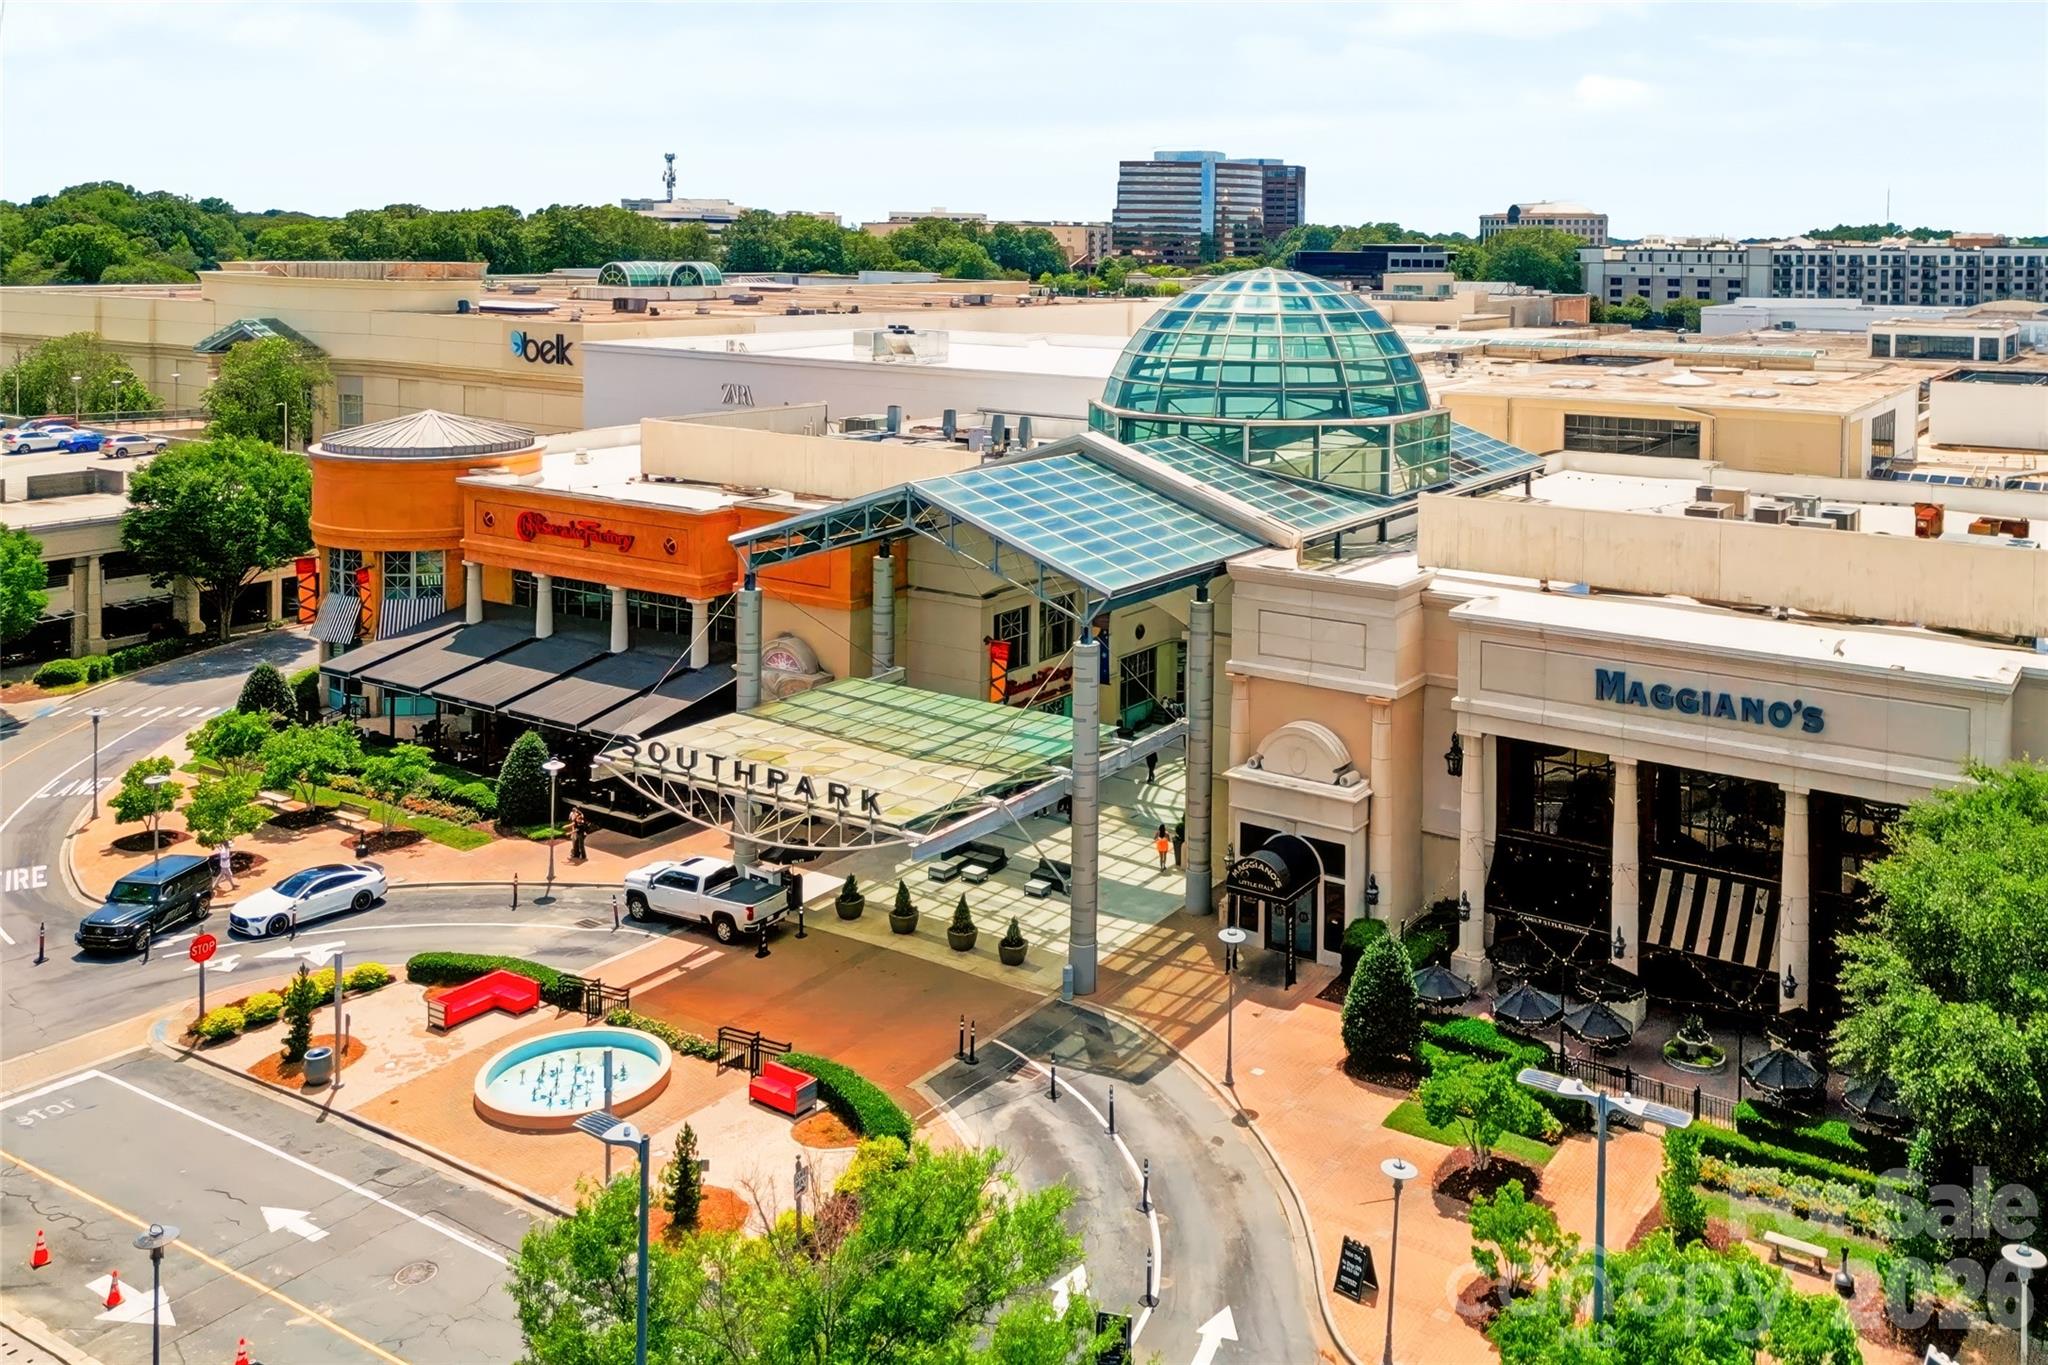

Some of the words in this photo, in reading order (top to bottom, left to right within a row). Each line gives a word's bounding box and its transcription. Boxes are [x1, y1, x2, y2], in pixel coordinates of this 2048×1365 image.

[522, 331, 574, 366] belk
[721, 383, 755, 407] ZARA
[620, 734, 882, 816] SOUTHPARK
[0, 864, 48, 893] IRE
[1231, 859, 1283, 889] MAGGIANO'S
[1238, 880, 1258, 889] LITTLE
[1258, 883, 1275, 892] ITALY
[191, 940, 216, 957] STOP
